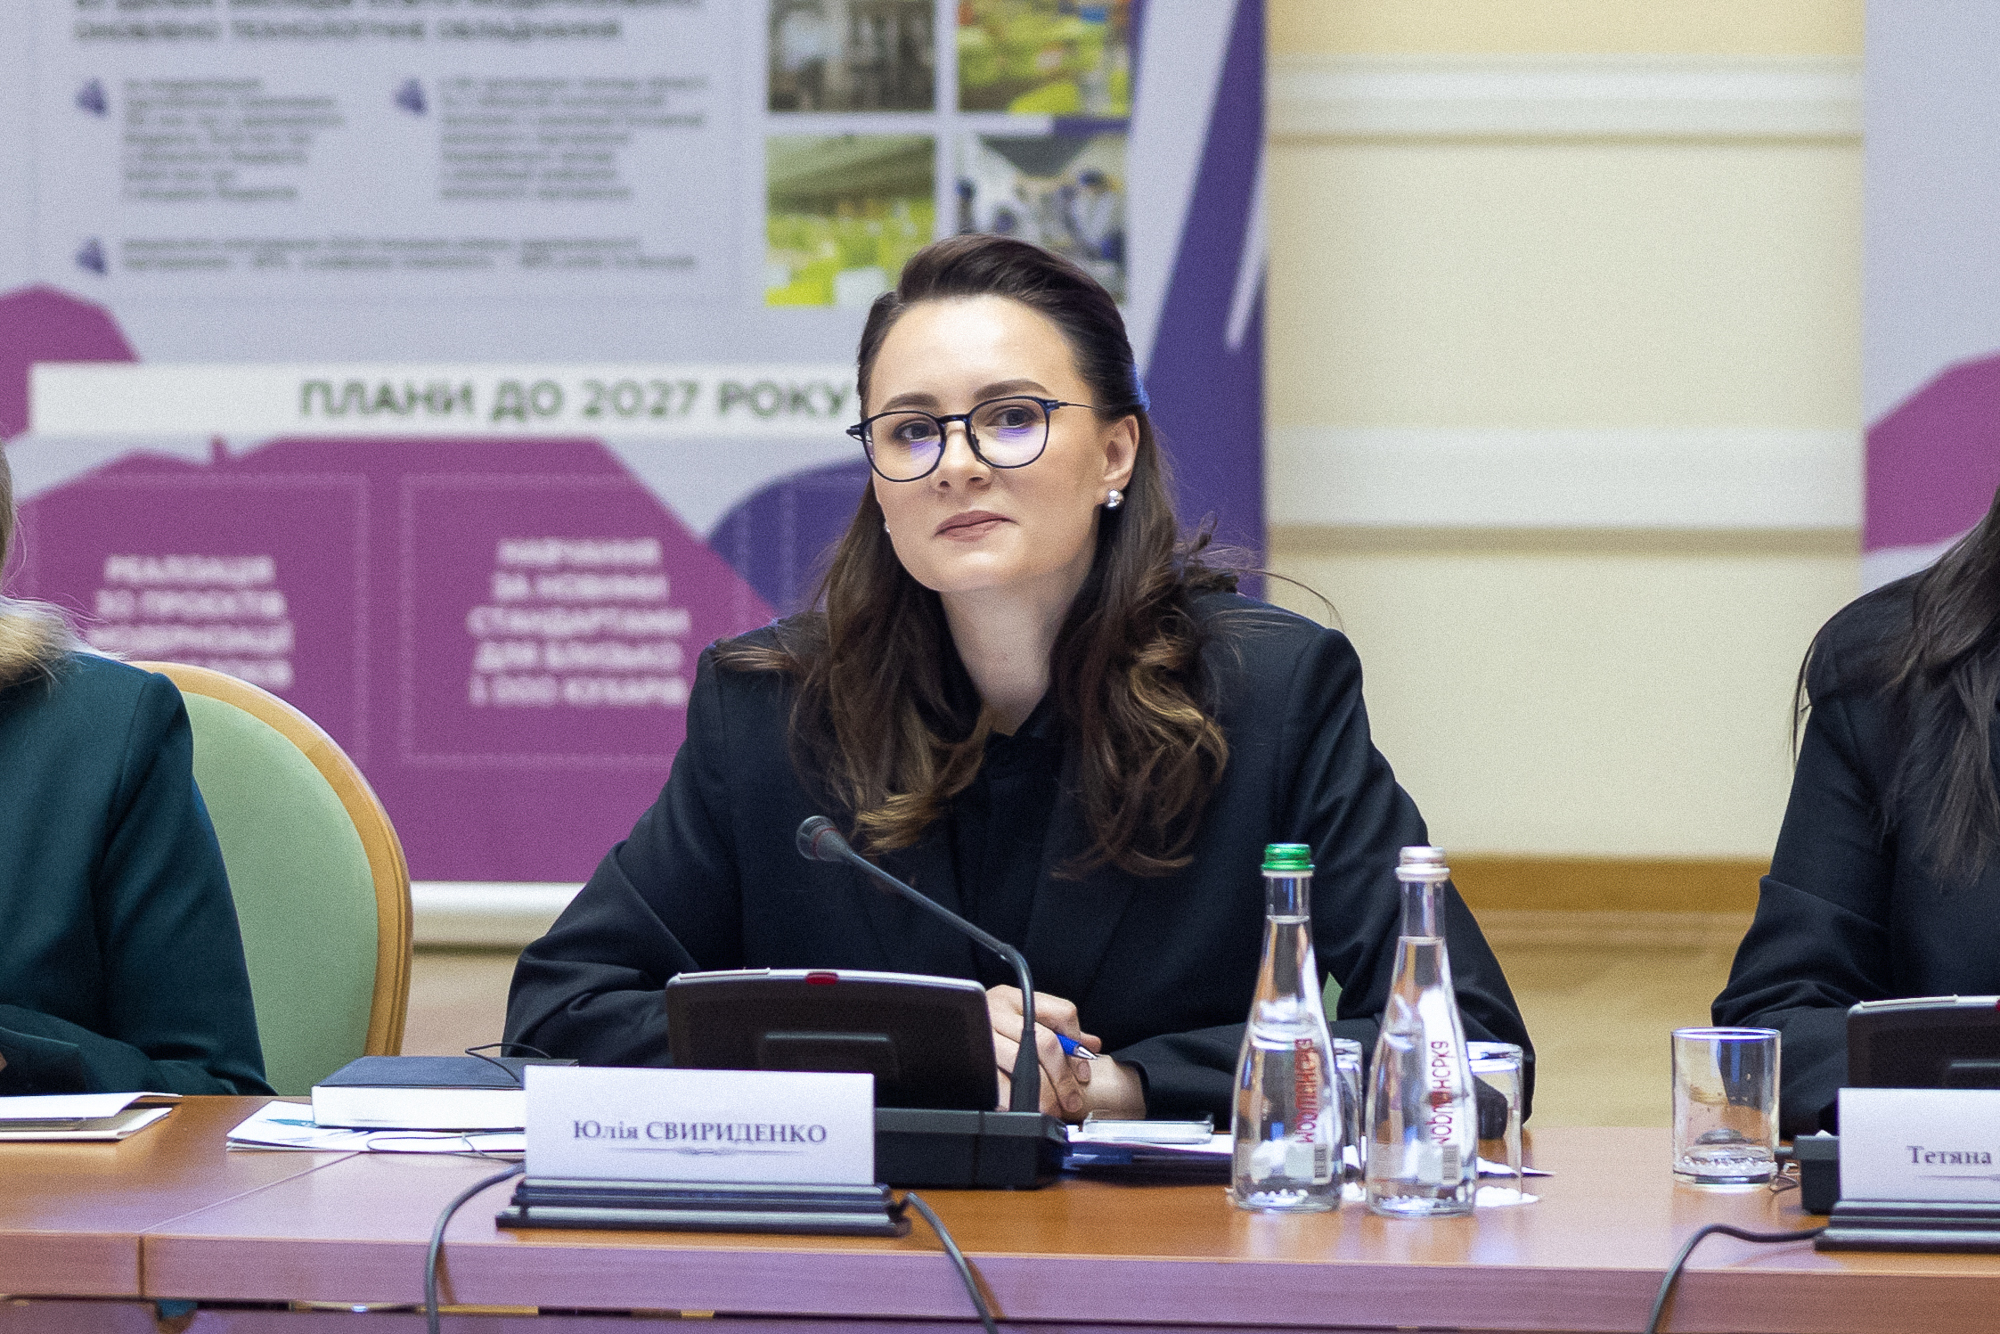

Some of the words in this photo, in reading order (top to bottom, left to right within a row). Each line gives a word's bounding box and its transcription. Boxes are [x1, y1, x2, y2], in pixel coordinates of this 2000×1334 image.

[301, 378, 474, 418] ПЛАНИ
[492, 378, 566, 423] ДО
[579, 378, 699, 418] 2027
[718, 378, 850, 418] РОКУ
[573, 1120, 638, 1140] Юлія
[646, 1120, 827, 1145] СВИРИДЕНКО
[1905, 1145, 1992, 1165] Тетяна
